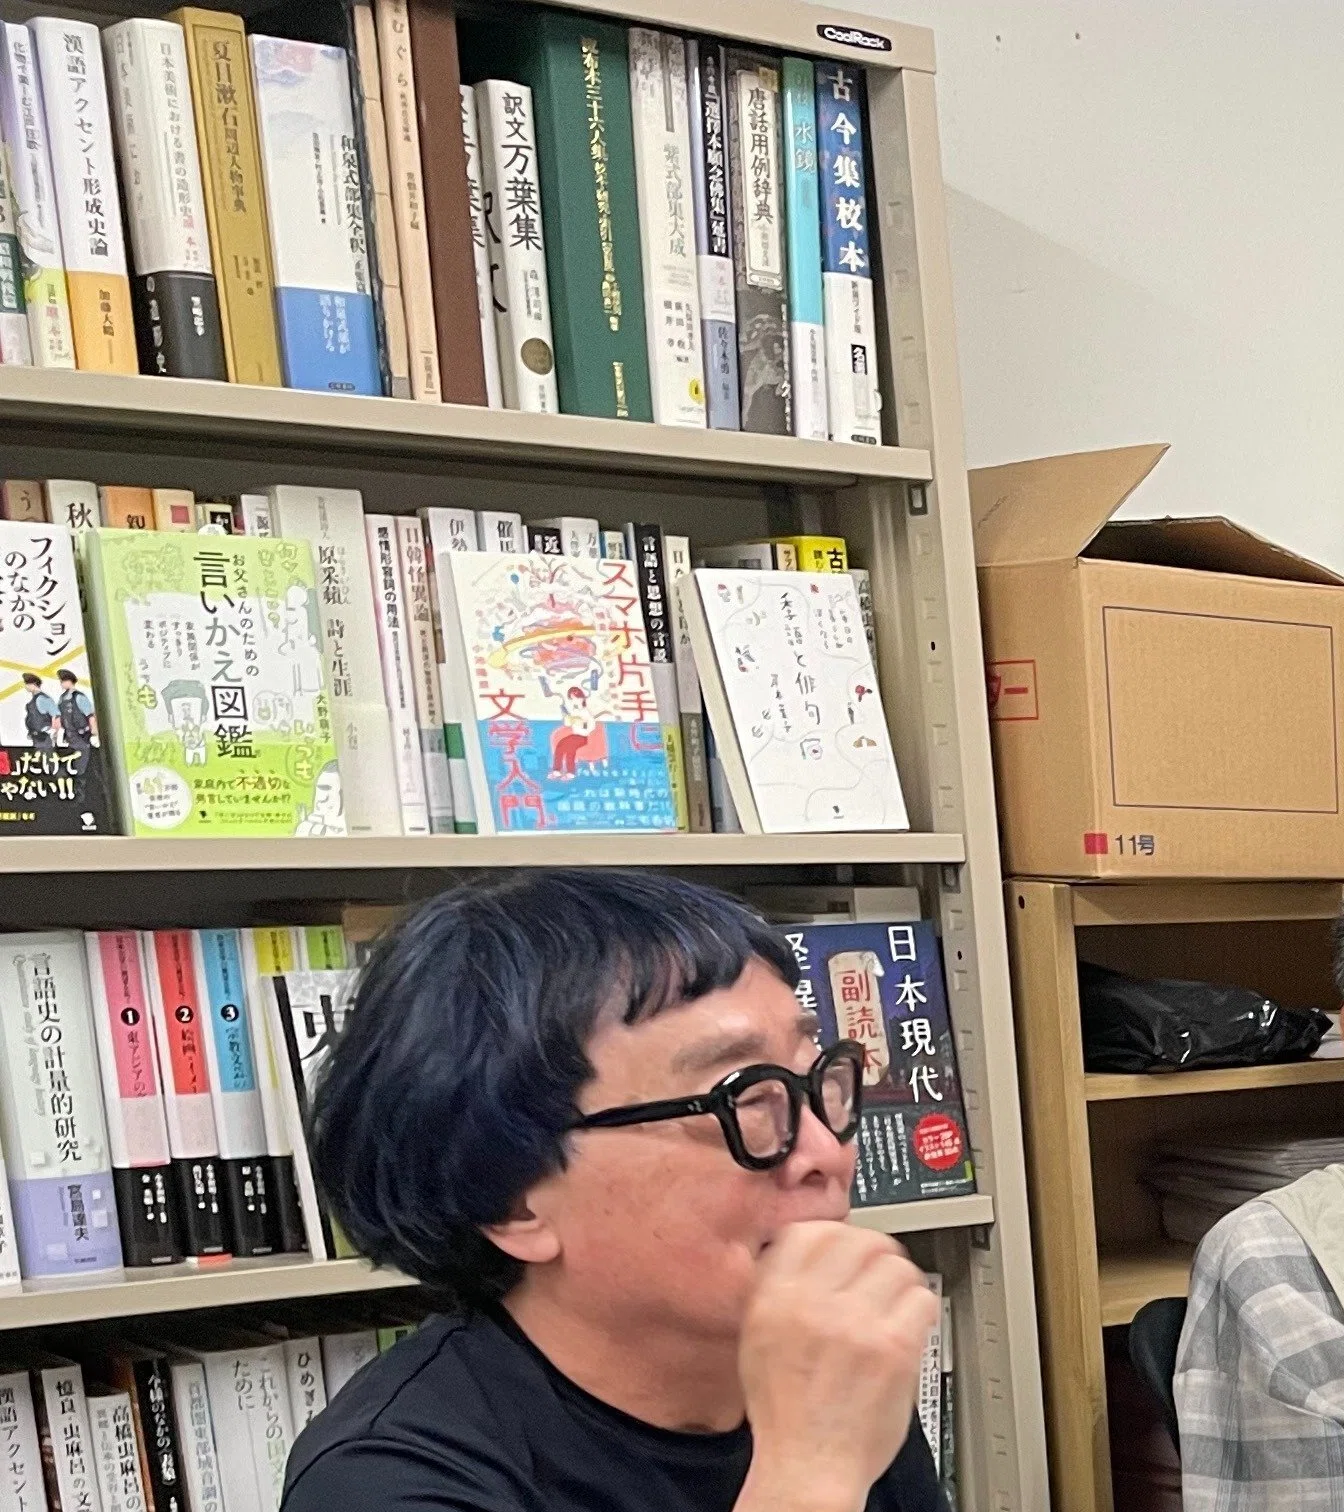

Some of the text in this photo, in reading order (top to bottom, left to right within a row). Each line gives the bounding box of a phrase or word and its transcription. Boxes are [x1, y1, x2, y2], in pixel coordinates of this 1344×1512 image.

[822, 25, 886, 50] CoolRack
[63, 32, 109, 258] 漢語アクセント形成史論
[500, 91, 544, 251] 訳文万葉集
[747, 86, 775, 225] 唐話用例辞典
[66, 502, 94, 529] 秋
[5, 550, 36, 632] のなかの
[30, 537, 72, 657] フィクション
[193, 551, 258, 759] 言いかえ図鑑
[232, 553, 260, 677] お父さんのための
[602, 562, 664, 751] スマホ片手に
[479, 688, 546, 829] 文学入門
[1114, 832, 1156, 857] 11号
[29, 951, 83, 1164] 言語史の計量的研究
[841, 968, 882, 1073] 副読本
[887, 925, 944, 1104] 日本現代
[231, 1359, 256, 1411] ために
